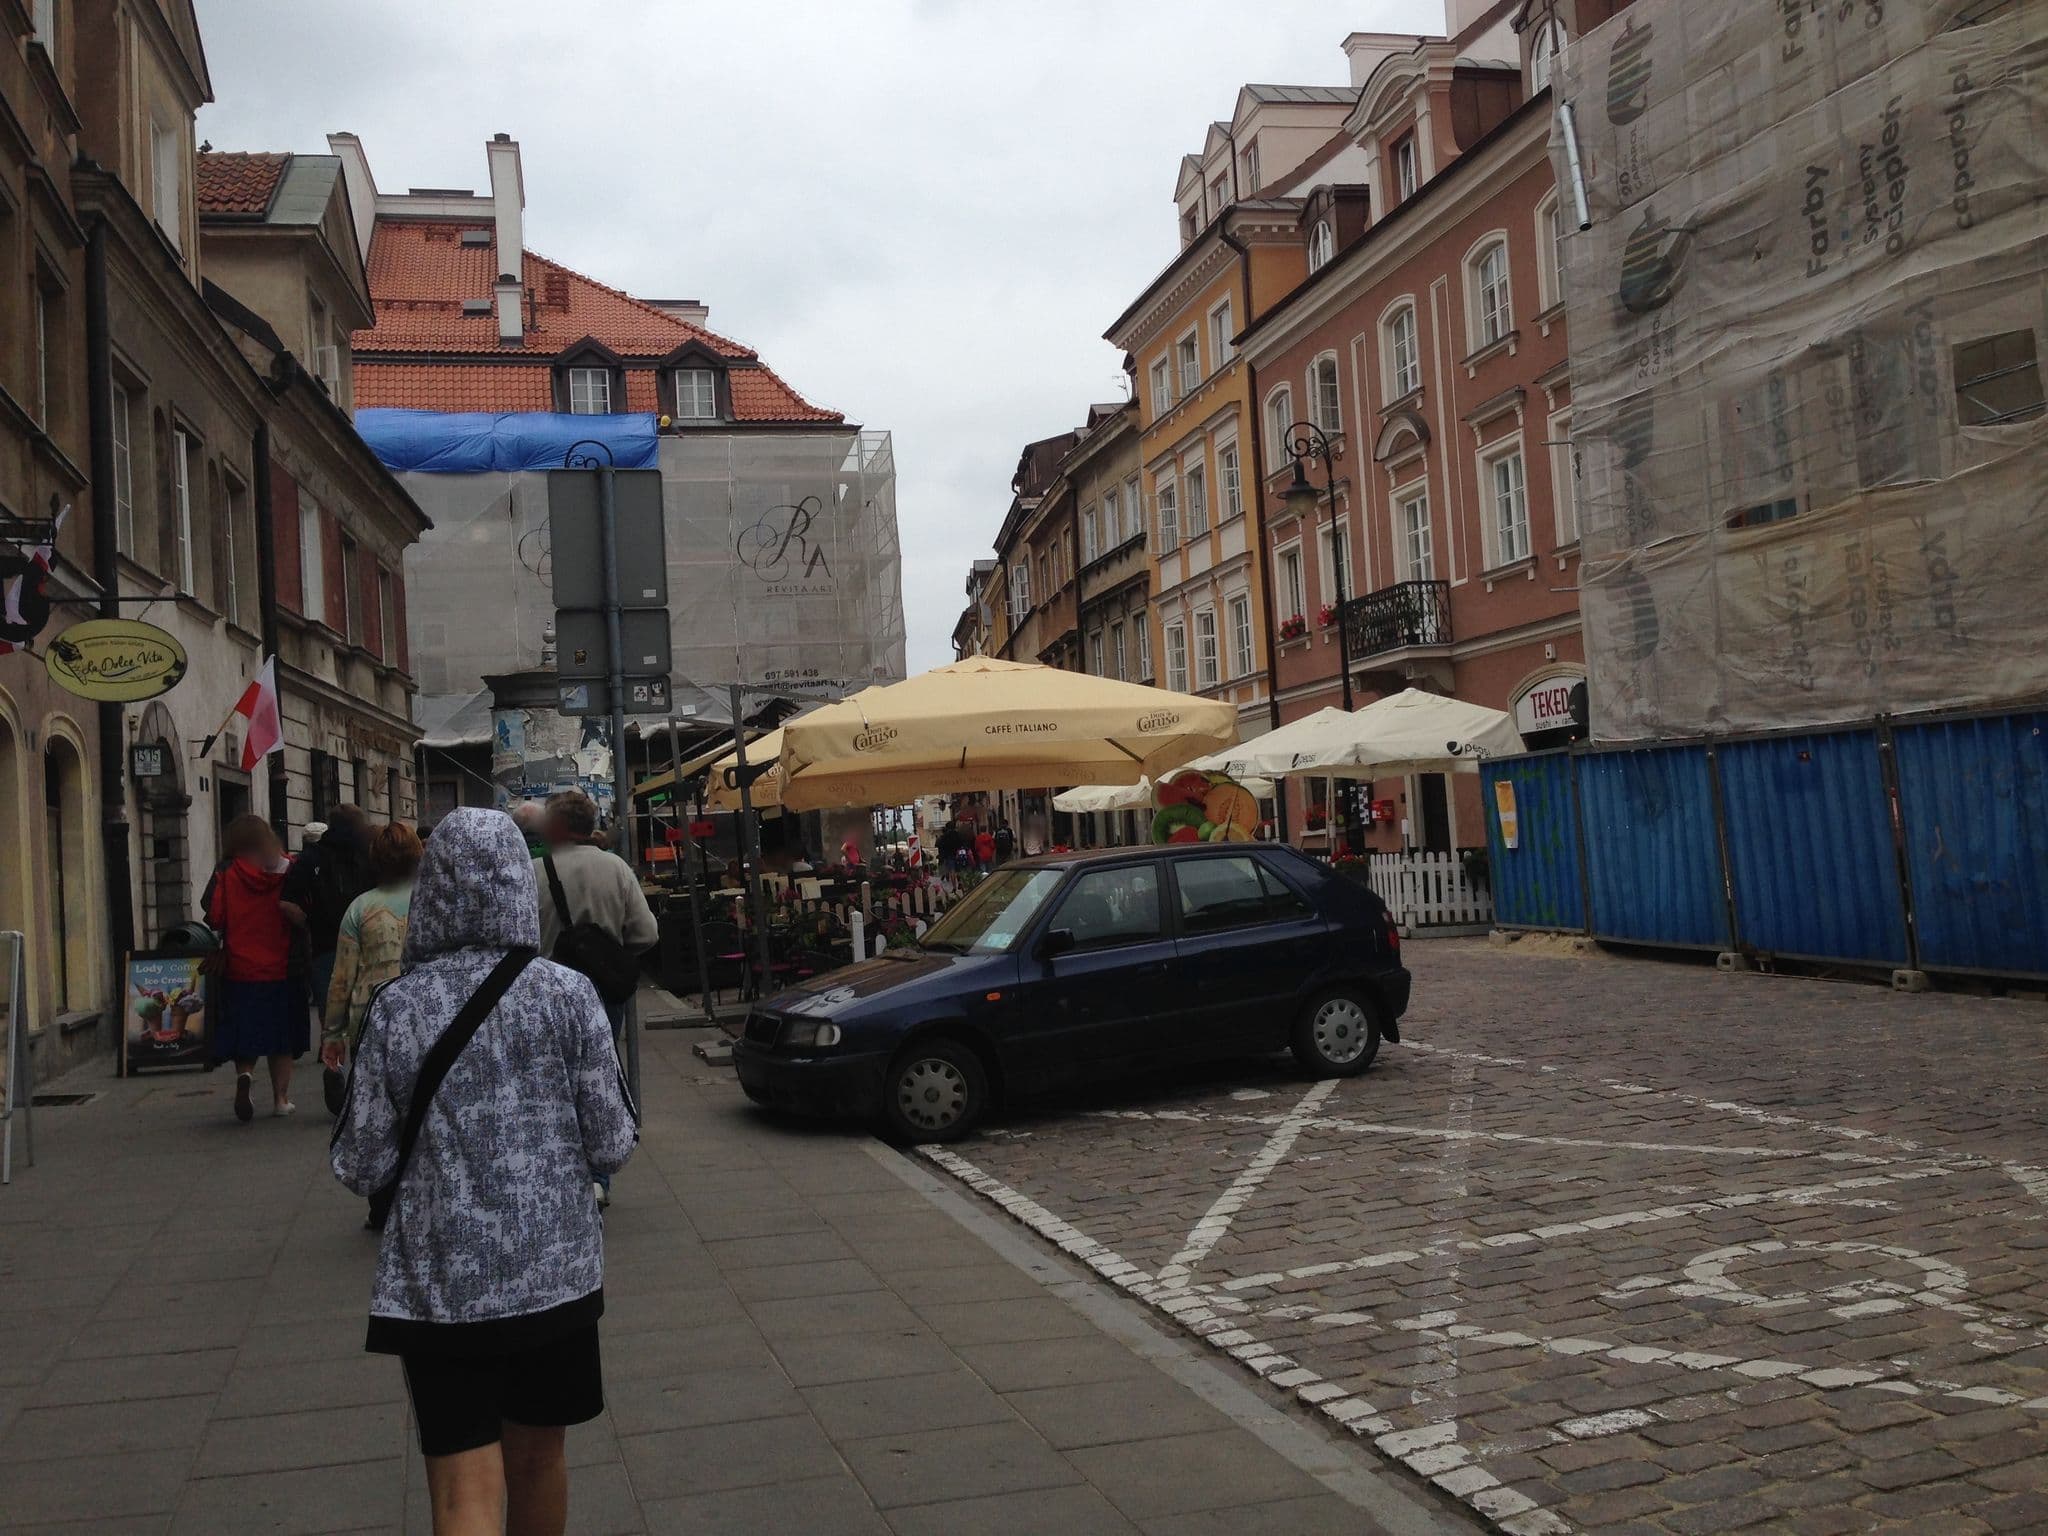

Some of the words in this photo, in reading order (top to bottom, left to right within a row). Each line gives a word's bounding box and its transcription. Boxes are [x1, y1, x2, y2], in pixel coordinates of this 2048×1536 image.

[1619, 171, 1633, 197] 20
[1859, 143, 1882, 245] Systemy
[1801, 164, 1830, 279] Farby
[812, 584, 833, 593] ART
[82, 658, 99, 675] La
[98, 656, 134, 673] Dolce
[137, 651, 165, 665] Vita
[1015, 723, 1057, 732] ITALIANO
[1136, 713, 1180, 733] Caruso
[852, 728, 898, 752] Caruso
[135, 964, 163, 974] Lody
